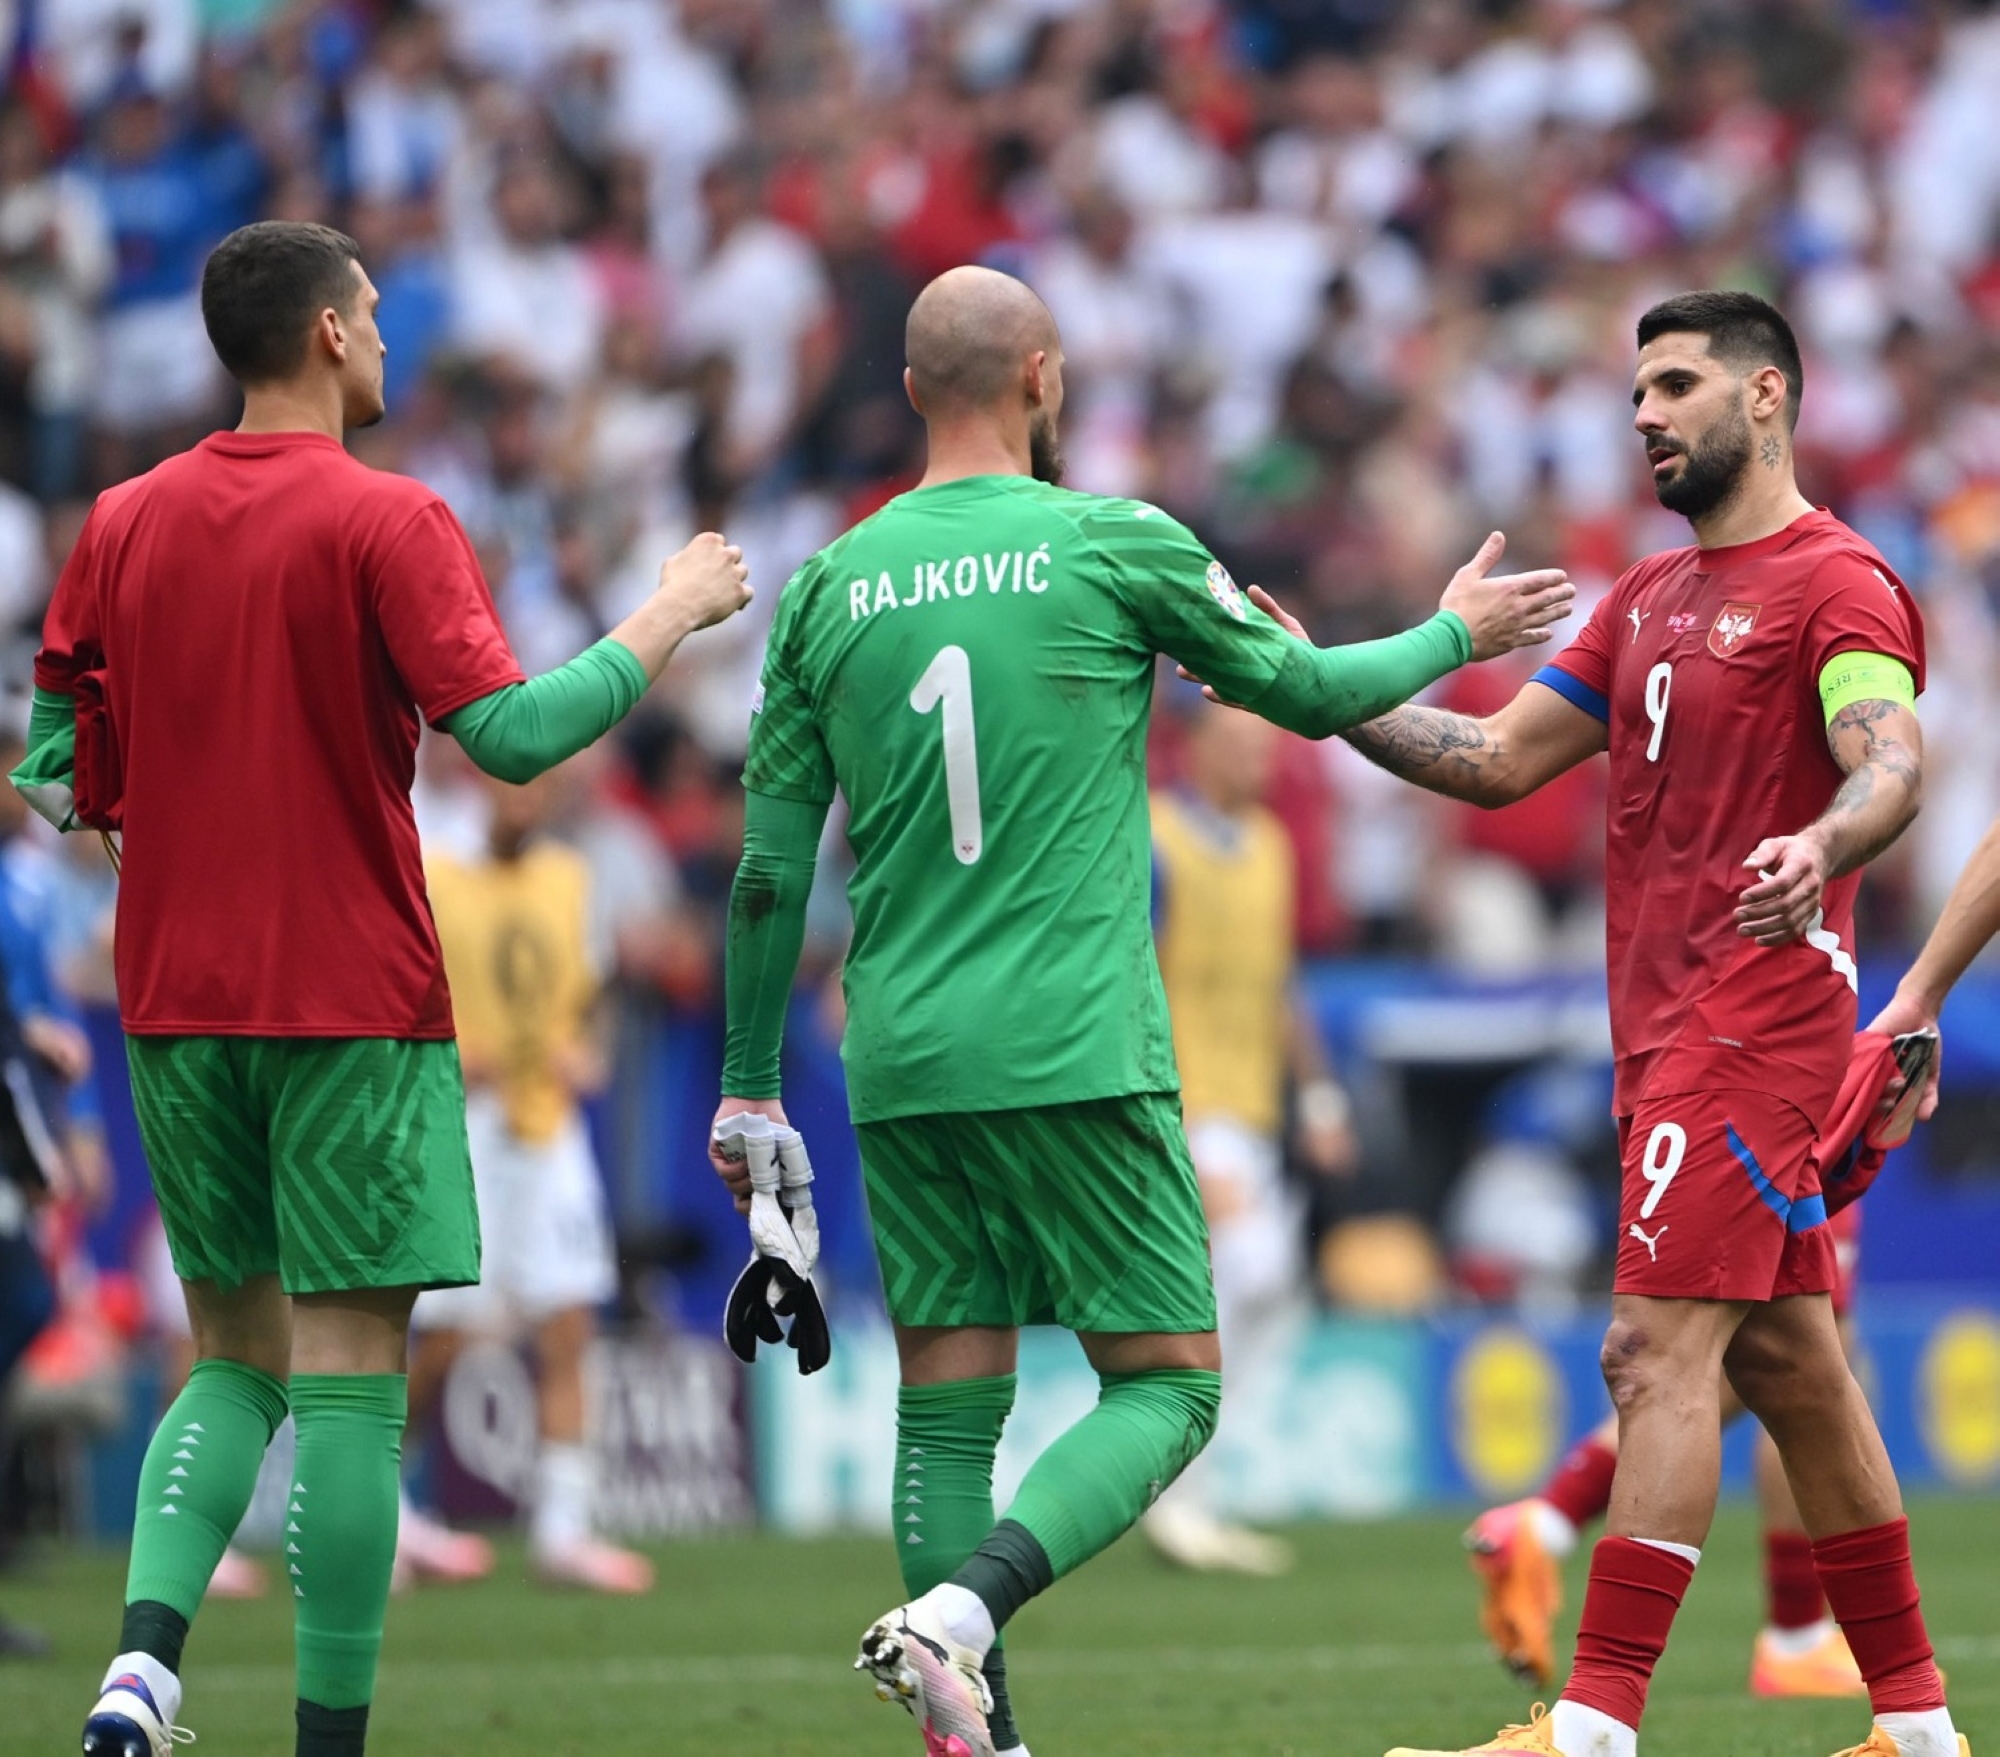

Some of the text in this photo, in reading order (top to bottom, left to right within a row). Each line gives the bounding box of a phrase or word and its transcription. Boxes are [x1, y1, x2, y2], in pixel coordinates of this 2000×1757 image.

[849, 542, 1051, 621] RAJKOVIĆ
[909, 644, 983, 865] 1
[1645, 662, 1673, 762] 9
[1640, 1121, 1688, 1219] 9
